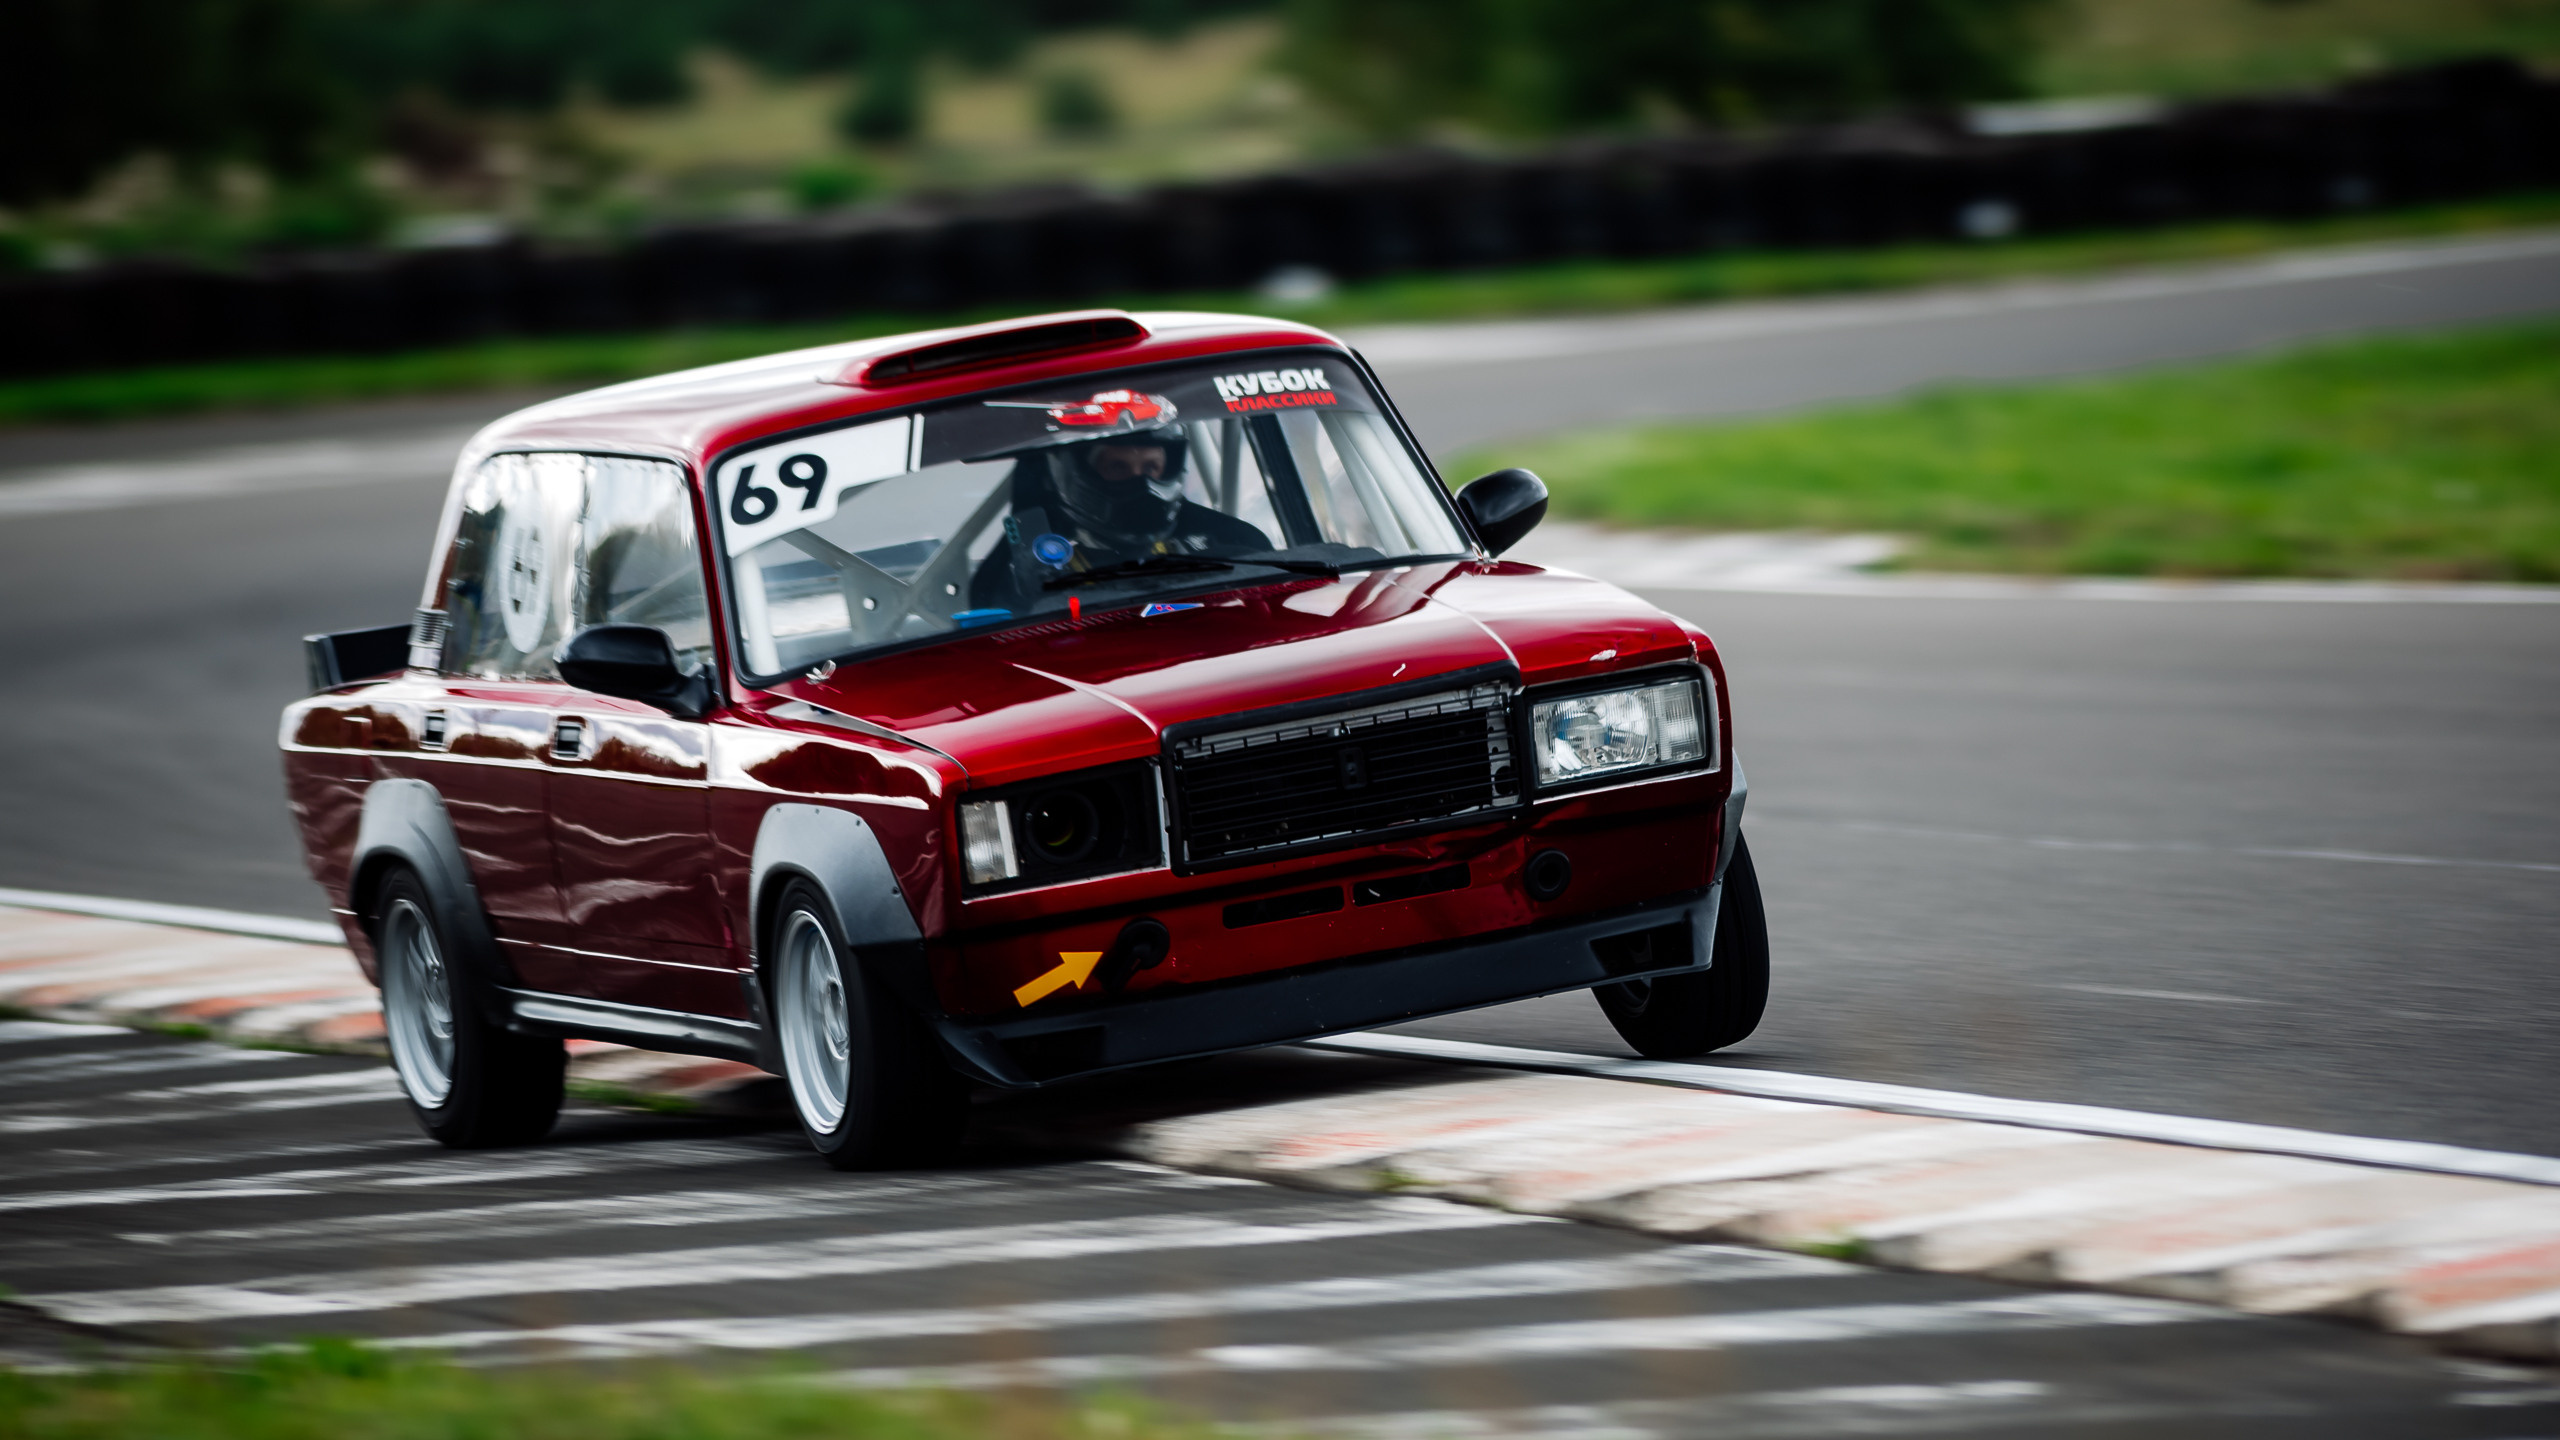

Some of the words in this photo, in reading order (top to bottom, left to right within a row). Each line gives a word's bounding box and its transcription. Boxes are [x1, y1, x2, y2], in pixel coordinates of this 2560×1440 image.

[1213, 368, 1331, 398] КУБОК
[1223, 391, 1338, 413] КЛАССИКИ
[731, 454, 828, 525] 69
